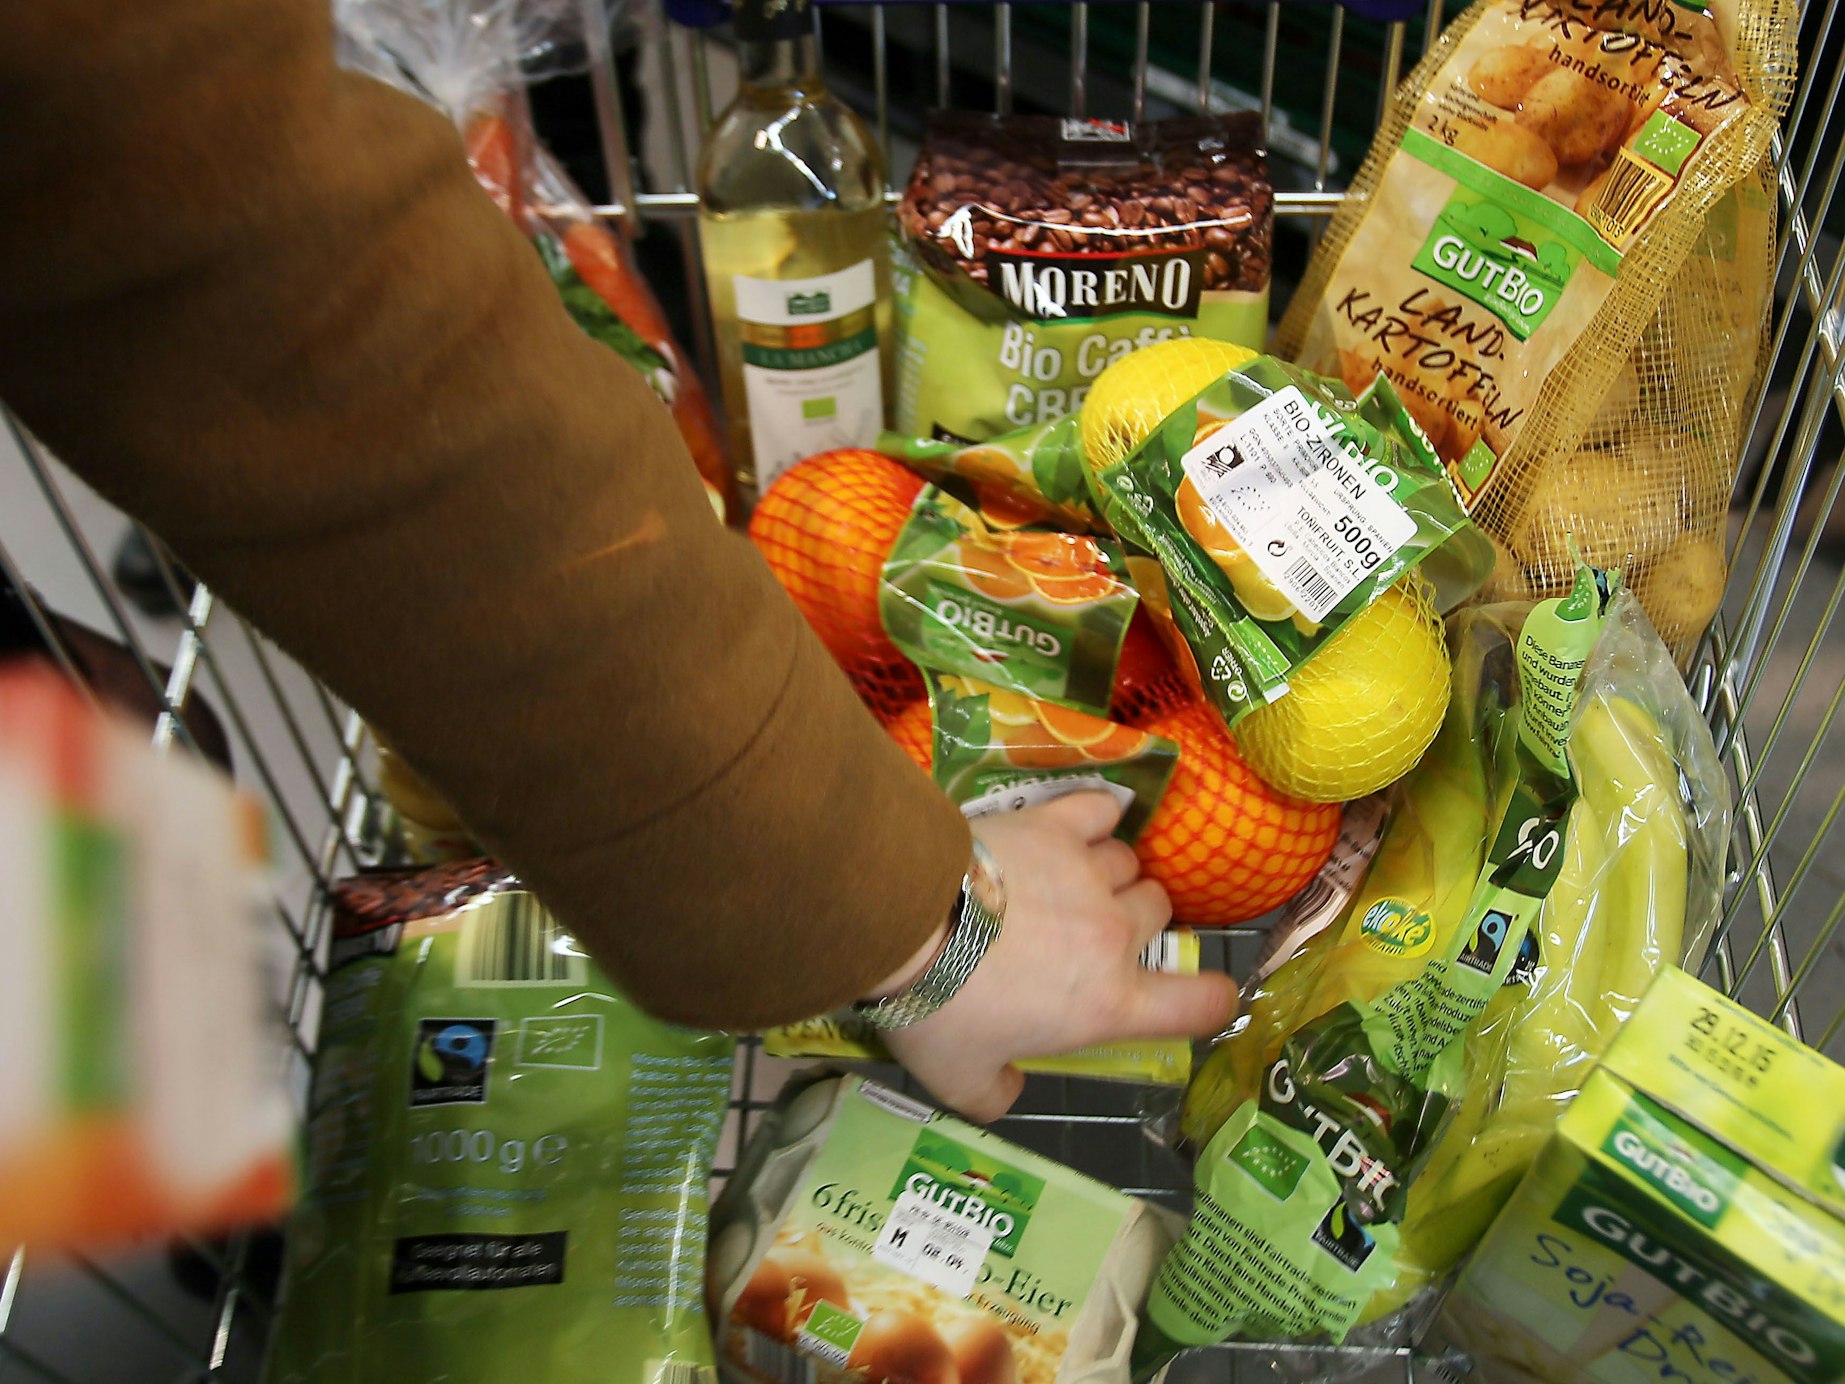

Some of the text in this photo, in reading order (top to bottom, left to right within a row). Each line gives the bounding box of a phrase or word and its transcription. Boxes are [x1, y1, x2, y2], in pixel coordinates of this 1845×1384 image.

[1427, 115, 1458, 147] 2 kg
[1000, 257, 1191, 316] MORENO
[999, 321, 1062, 382] Bio
[1332, 514, 1384, 570] 500g
[1521, 651, 1538, 669] und
[1523, 634, 1550, 661] Diese
[833, 1188, 887, 1233] fris
